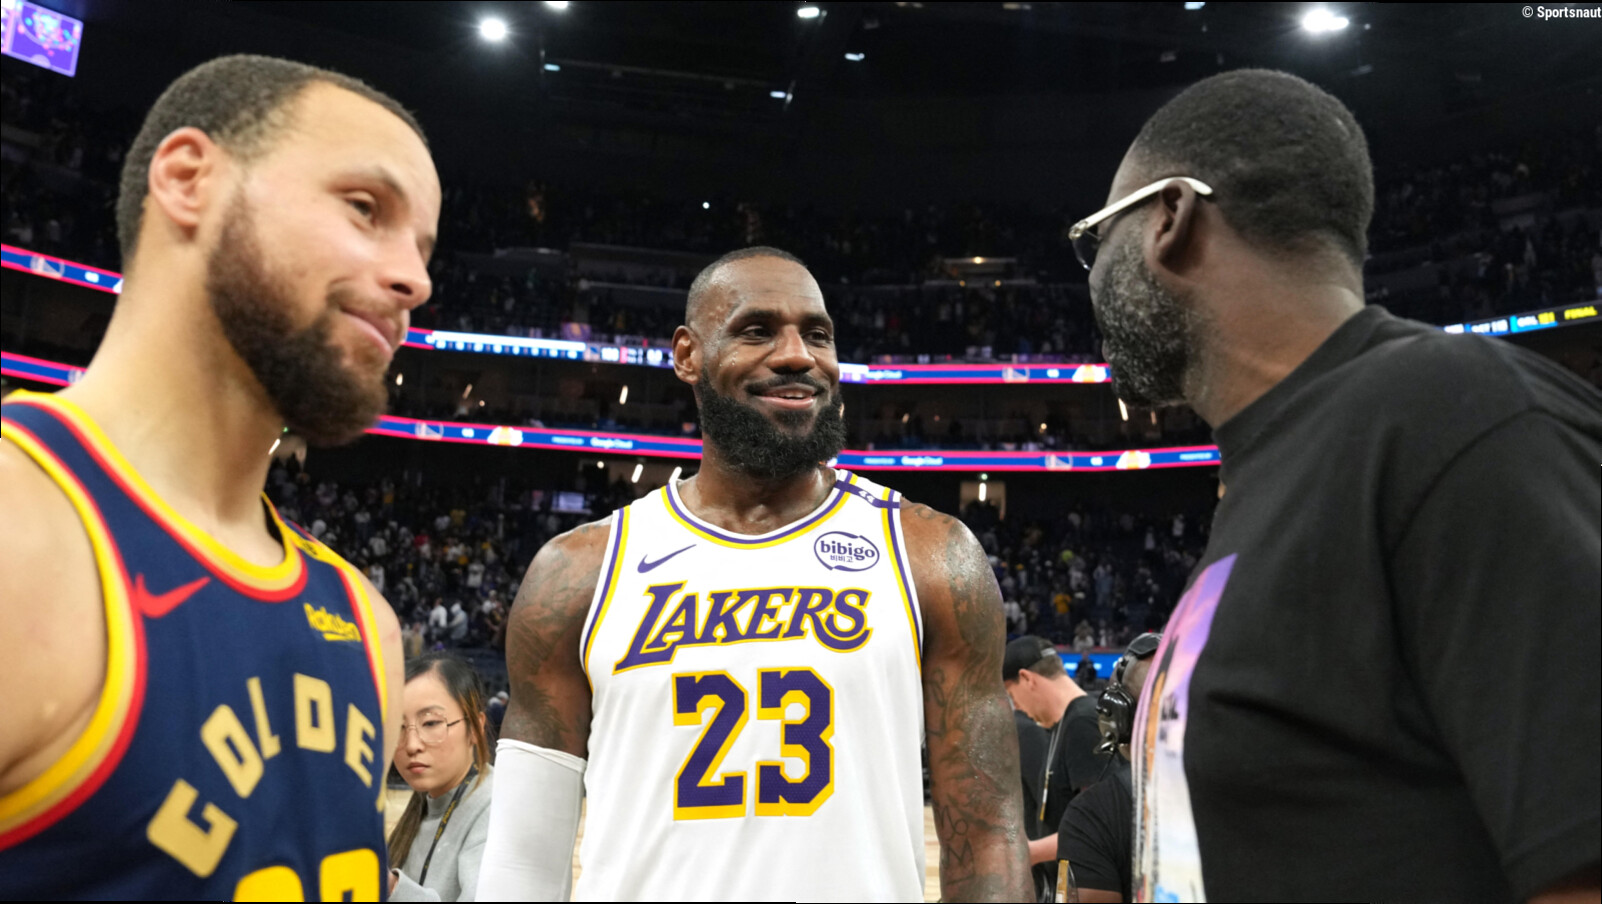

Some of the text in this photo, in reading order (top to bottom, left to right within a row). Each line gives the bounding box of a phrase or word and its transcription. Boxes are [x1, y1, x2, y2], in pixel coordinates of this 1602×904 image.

[820, 540, 876, 561] bibigo
[611, 579, 874, 676] LAKERS
[146, 672, 386, 878] GOLDE
[671, 666, 835, 821] 23
